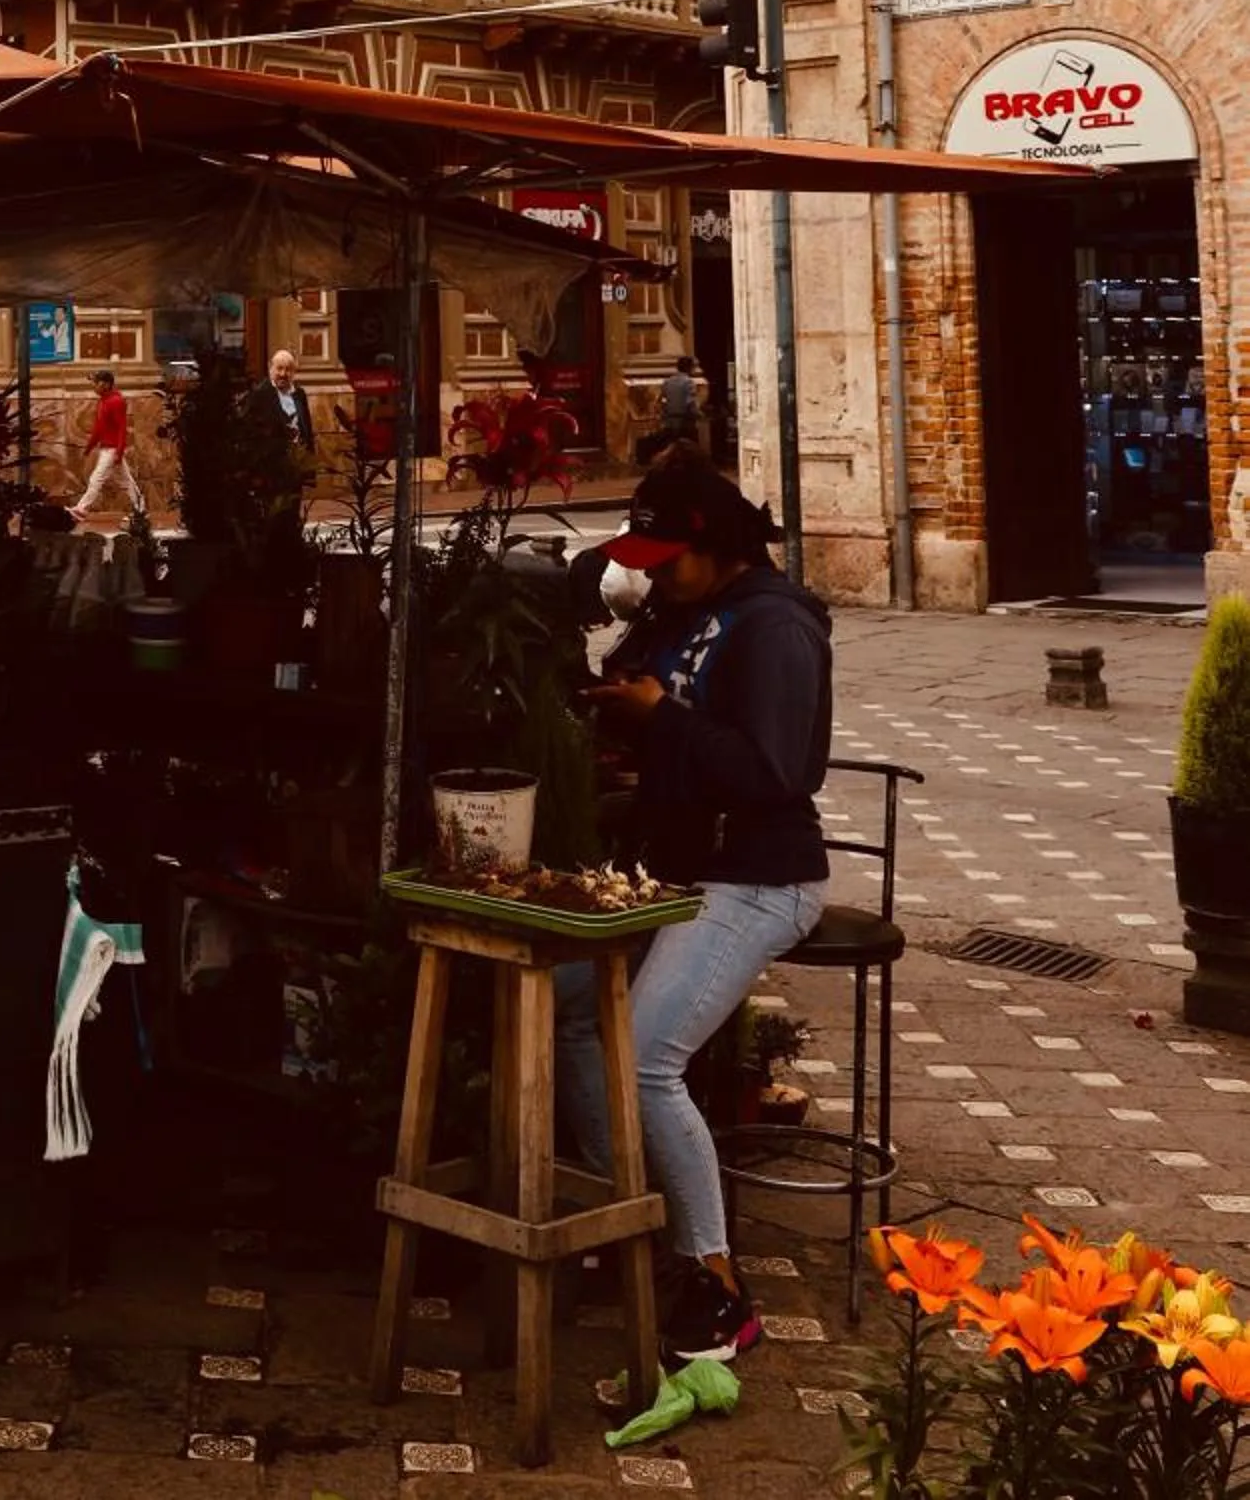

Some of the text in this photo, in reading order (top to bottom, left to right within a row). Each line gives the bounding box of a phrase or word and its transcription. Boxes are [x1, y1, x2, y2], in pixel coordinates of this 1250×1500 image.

[984, 83, 1143, 121] BRAVO
[1079, 112, 1135, 130] CELL
[1021, 143, 1103, 160] TECNOLOGIA
